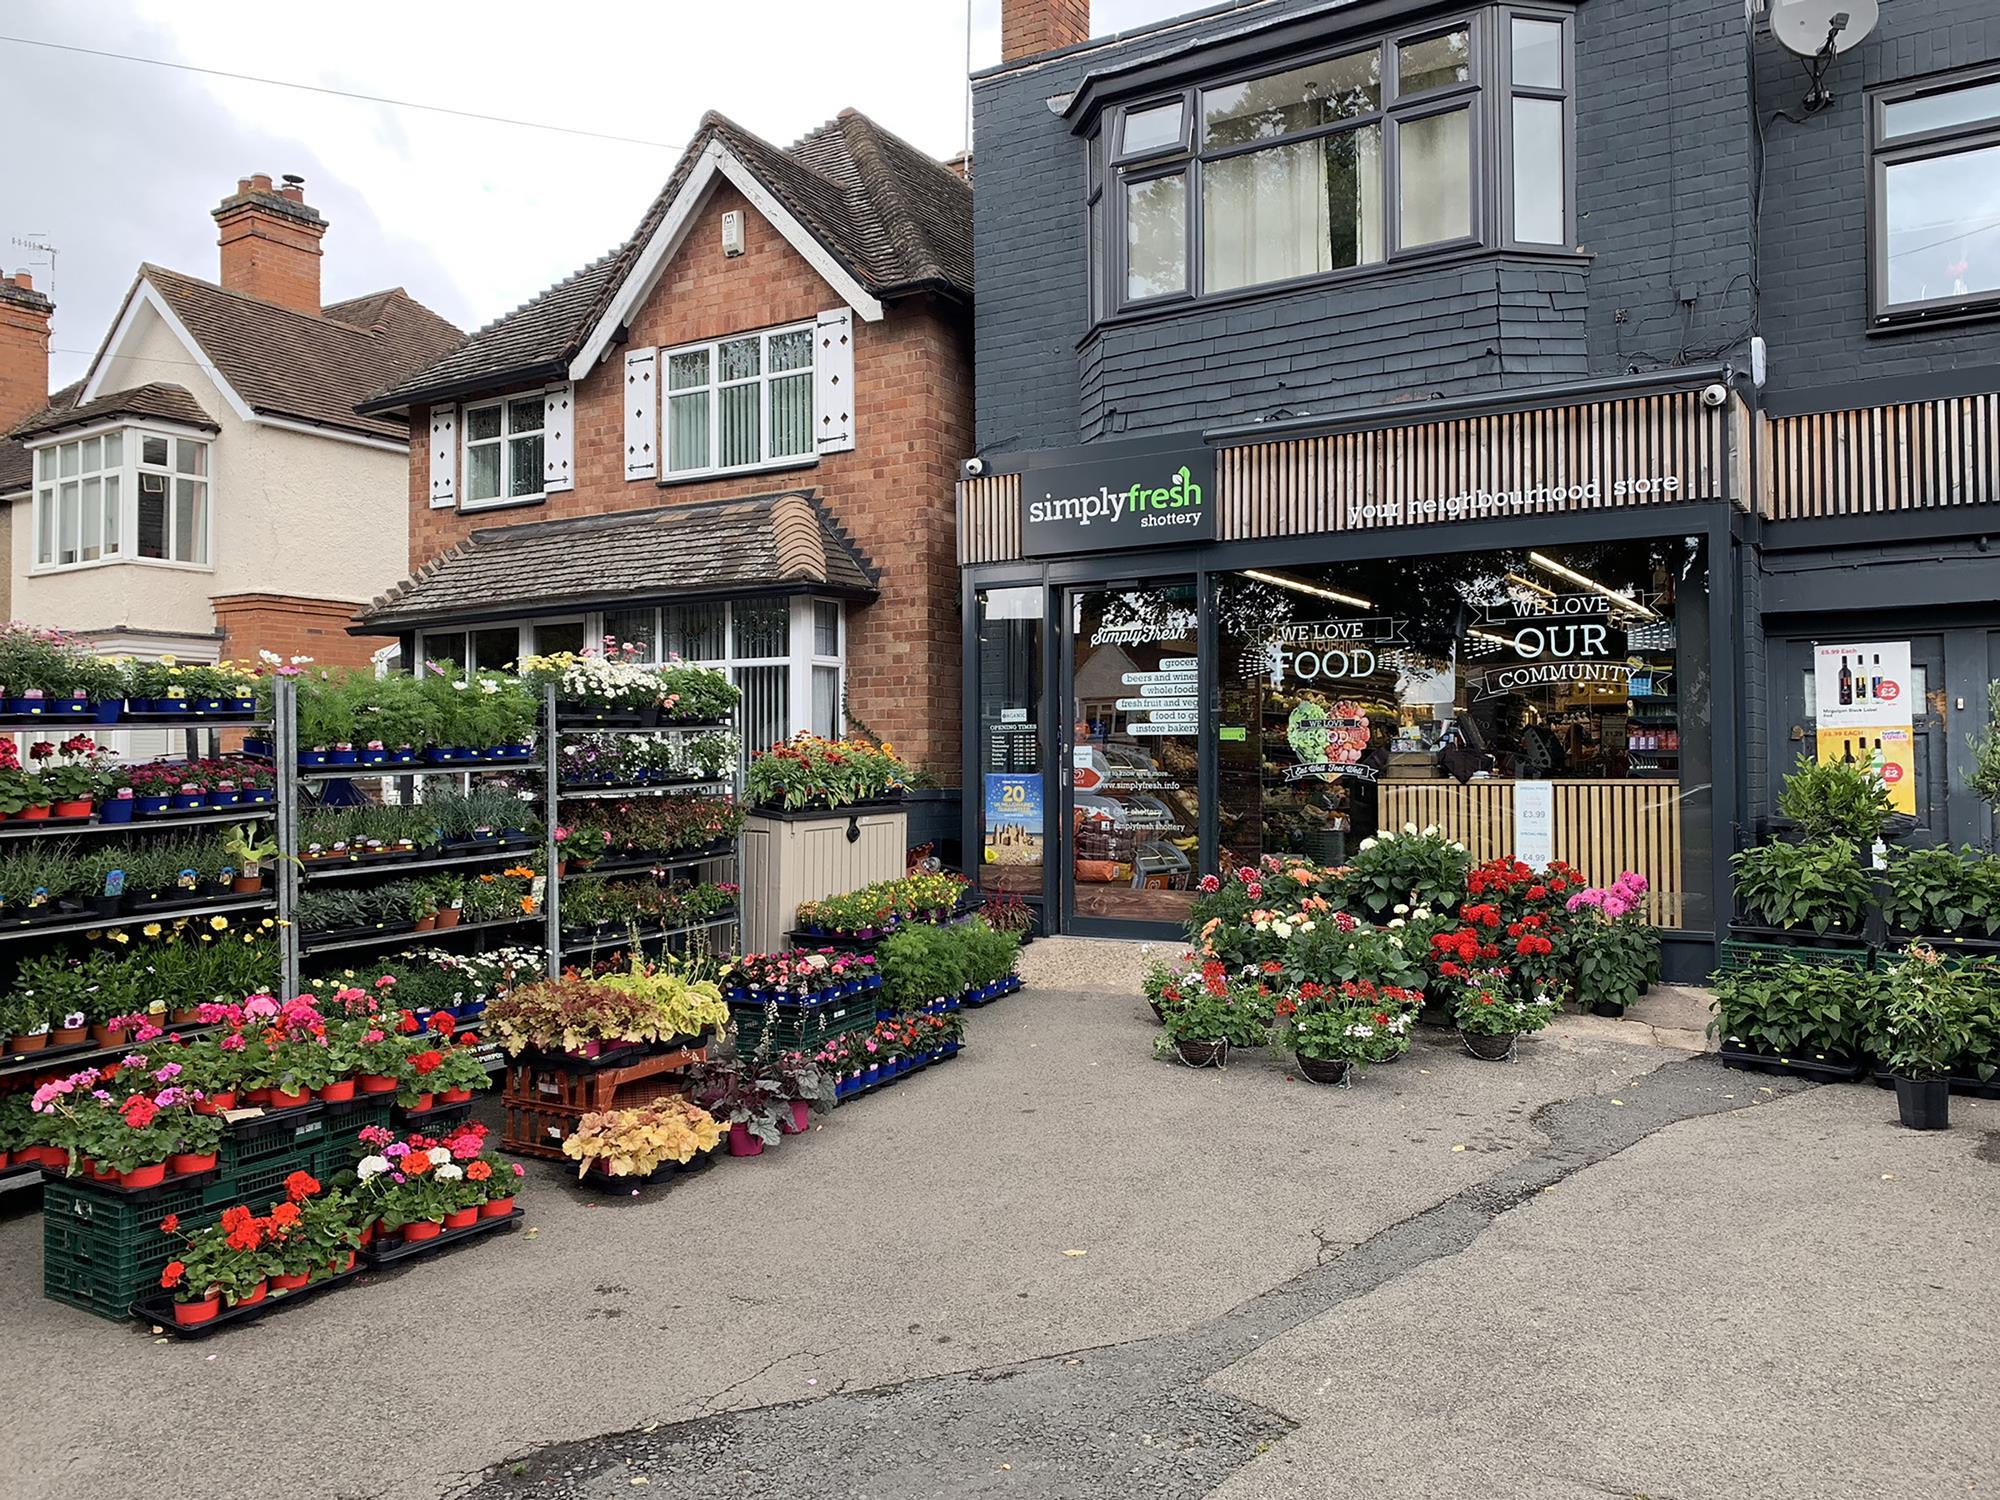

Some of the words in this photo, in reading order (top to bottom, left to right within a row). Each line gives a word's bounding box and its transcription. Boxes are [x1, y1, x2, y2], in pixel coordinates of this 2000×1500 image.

[1347, 501, 1399, 524] your
[1407, 478, 1601, 516] neighbourhood
[1613, 474, 1680, 497] store
[1140, 511, 1202, 528] shottery
[1512, 600, 1546, 617] WE
[1551, 596, 1611, 616] LOVE
[1090, 624, 1187, 648] SimplyFresh
[1280, 625, 1309, 641] WE
[1313, 622, 1364, 640] LOVE
[1514, 624, 1609, 659] OUR
[1164, 659, 1198, 669] grocery
[1275, 650, 1377, 679] FOOD
[1126, 674, 1152, 682] beers
[1154, 673, 1171, 681] and
[1172, 672, 1198, 681] wines
[1499, 663, 1640, 690] COMMUNITY
[1147, 686, 1173, 694] whole
[1174, 685, 1198, 693] foods
[1881, 687, 1897, 697] £2
[1121, 699, 1143, 708] fresh
[1143, 699, 1162, 707] fruit
[1163, 698, 1180, 707] and
[1182, 699, 1198, 709] veg
[1155, 711, 1175, 720] food
[1178, 711, 1186, 719] to
[1135, 725, 1166, 733] instore
[1167, 724, 1198, 734] bakery
[1885, 770, 1899, 778] £2
[1097, 781, 1181, 792] www.simplyfresh.info
[1002, 785, 1025, 802] 20
[1523, 810, 1546, 818] £3.99
[1523, 853, 1546, 862] £4.99
